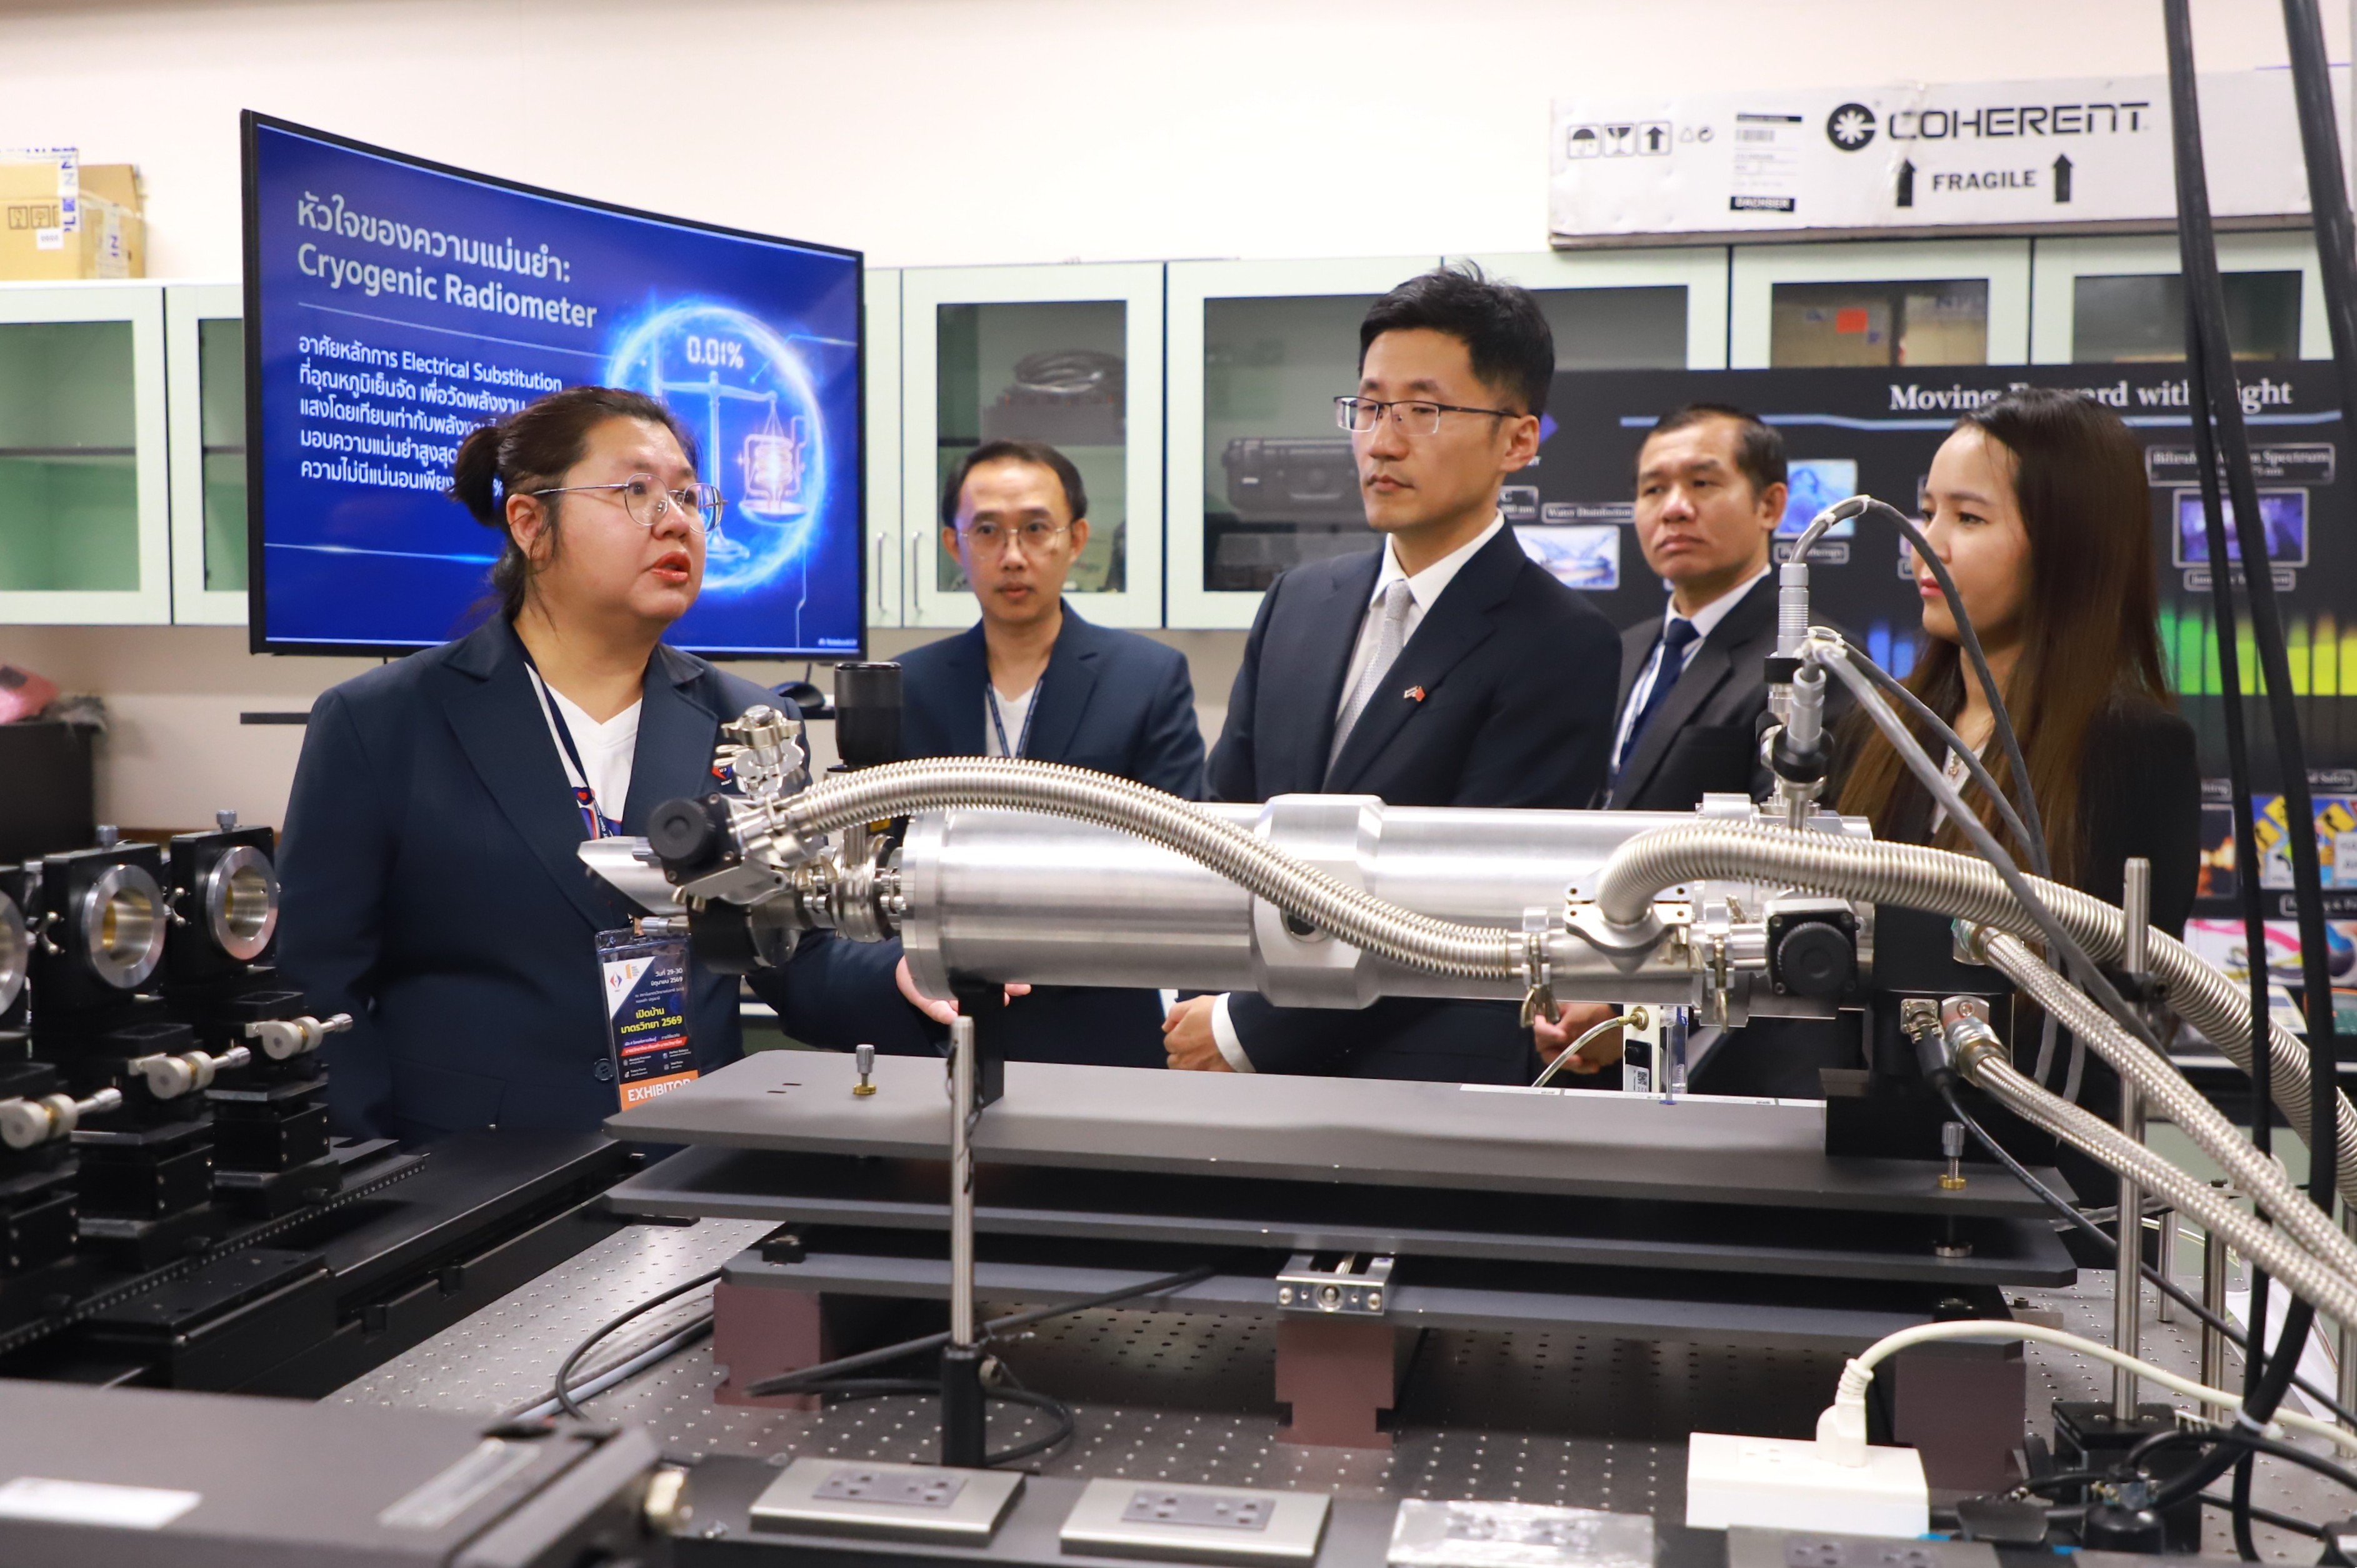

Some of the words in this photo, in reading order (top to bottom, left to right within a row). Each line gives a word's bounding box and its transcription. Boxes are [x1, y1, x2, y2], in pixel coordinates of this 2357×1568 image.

[1889, 102, 2149, 140] COHERENT
[1933, 169, 2038, 192] FRAGILE
[298, 190, 571, 282] หัวใจของความแม่นยำ:
[298, 242, 438, 301] Cryogenic
[444, 272, 598, 328] Radiometer
[299, 334, 399, 368] อาศัยหลักการ
[402, 350, 469, 380] Electrical
[473, 362, 563, 392] Substitution
[686, 335, 744, 369] 0.01%
[666, 967, 683, 976] 29-30
[621, 1021, 660, 1034] มาตรวิทยา
[661, 1015, 683, 1027] 2569
[636, 1006, 665, 1019] เปิดบ้าน
